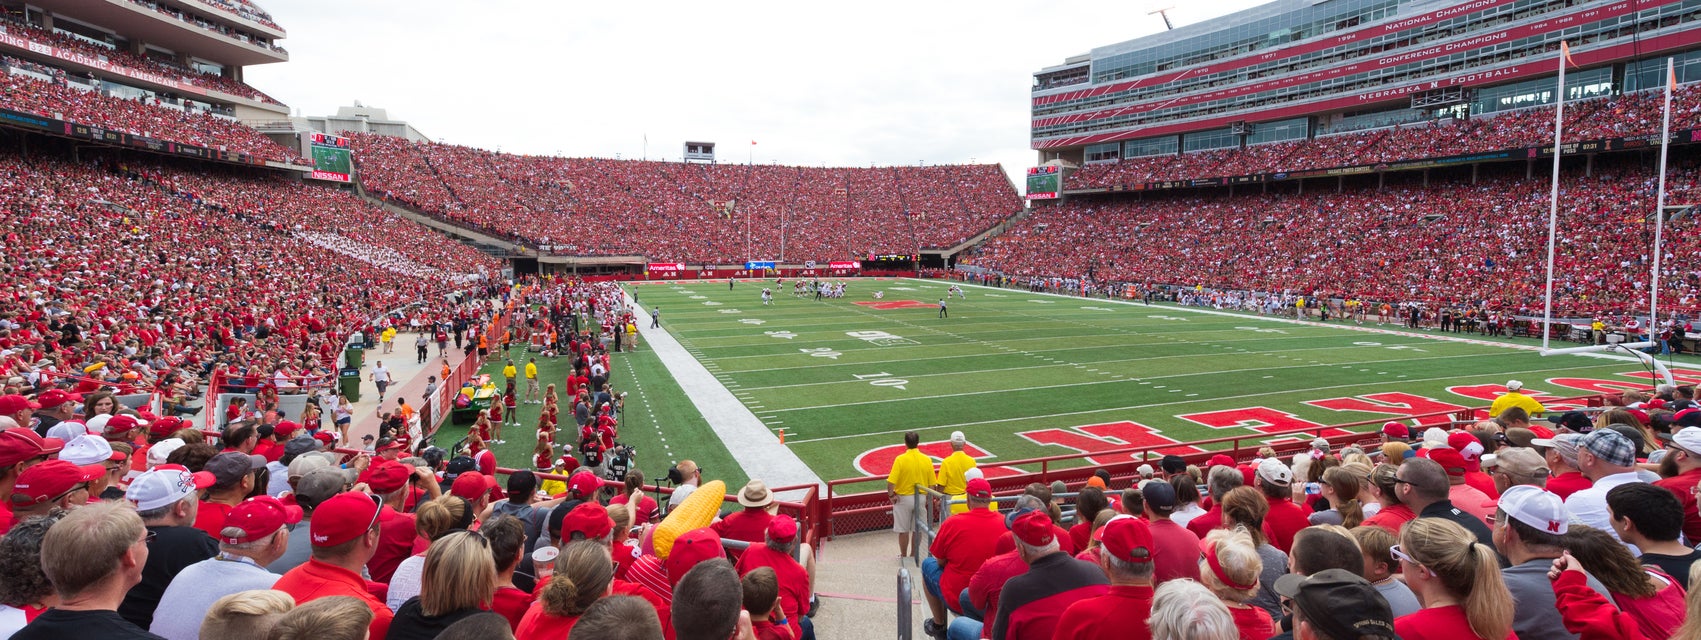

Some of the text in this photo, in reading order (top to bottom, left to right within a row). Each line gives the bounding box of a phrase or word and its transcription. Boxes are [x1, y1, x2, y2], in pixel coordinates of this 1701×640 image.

[1385, 0, 1497, 31] NATIONAL CHAMPIONS
[1379, 32, 1507, 65] CONFERENCE CHAMPIONS
[56, 50, 106, 69] ACADEMIC
[110, 65, 126, 75] ALL
[130, 69, 178, 88] AMERICANS
[1359, 85, 1421, 101] NEBRASKA
[1450, 67, 1519, 85] FOOTBALL
[314, 171, 344, 180] NISSAN
[851, 371, 909, 386] 10
[1547, 520, 1561, 533] N
